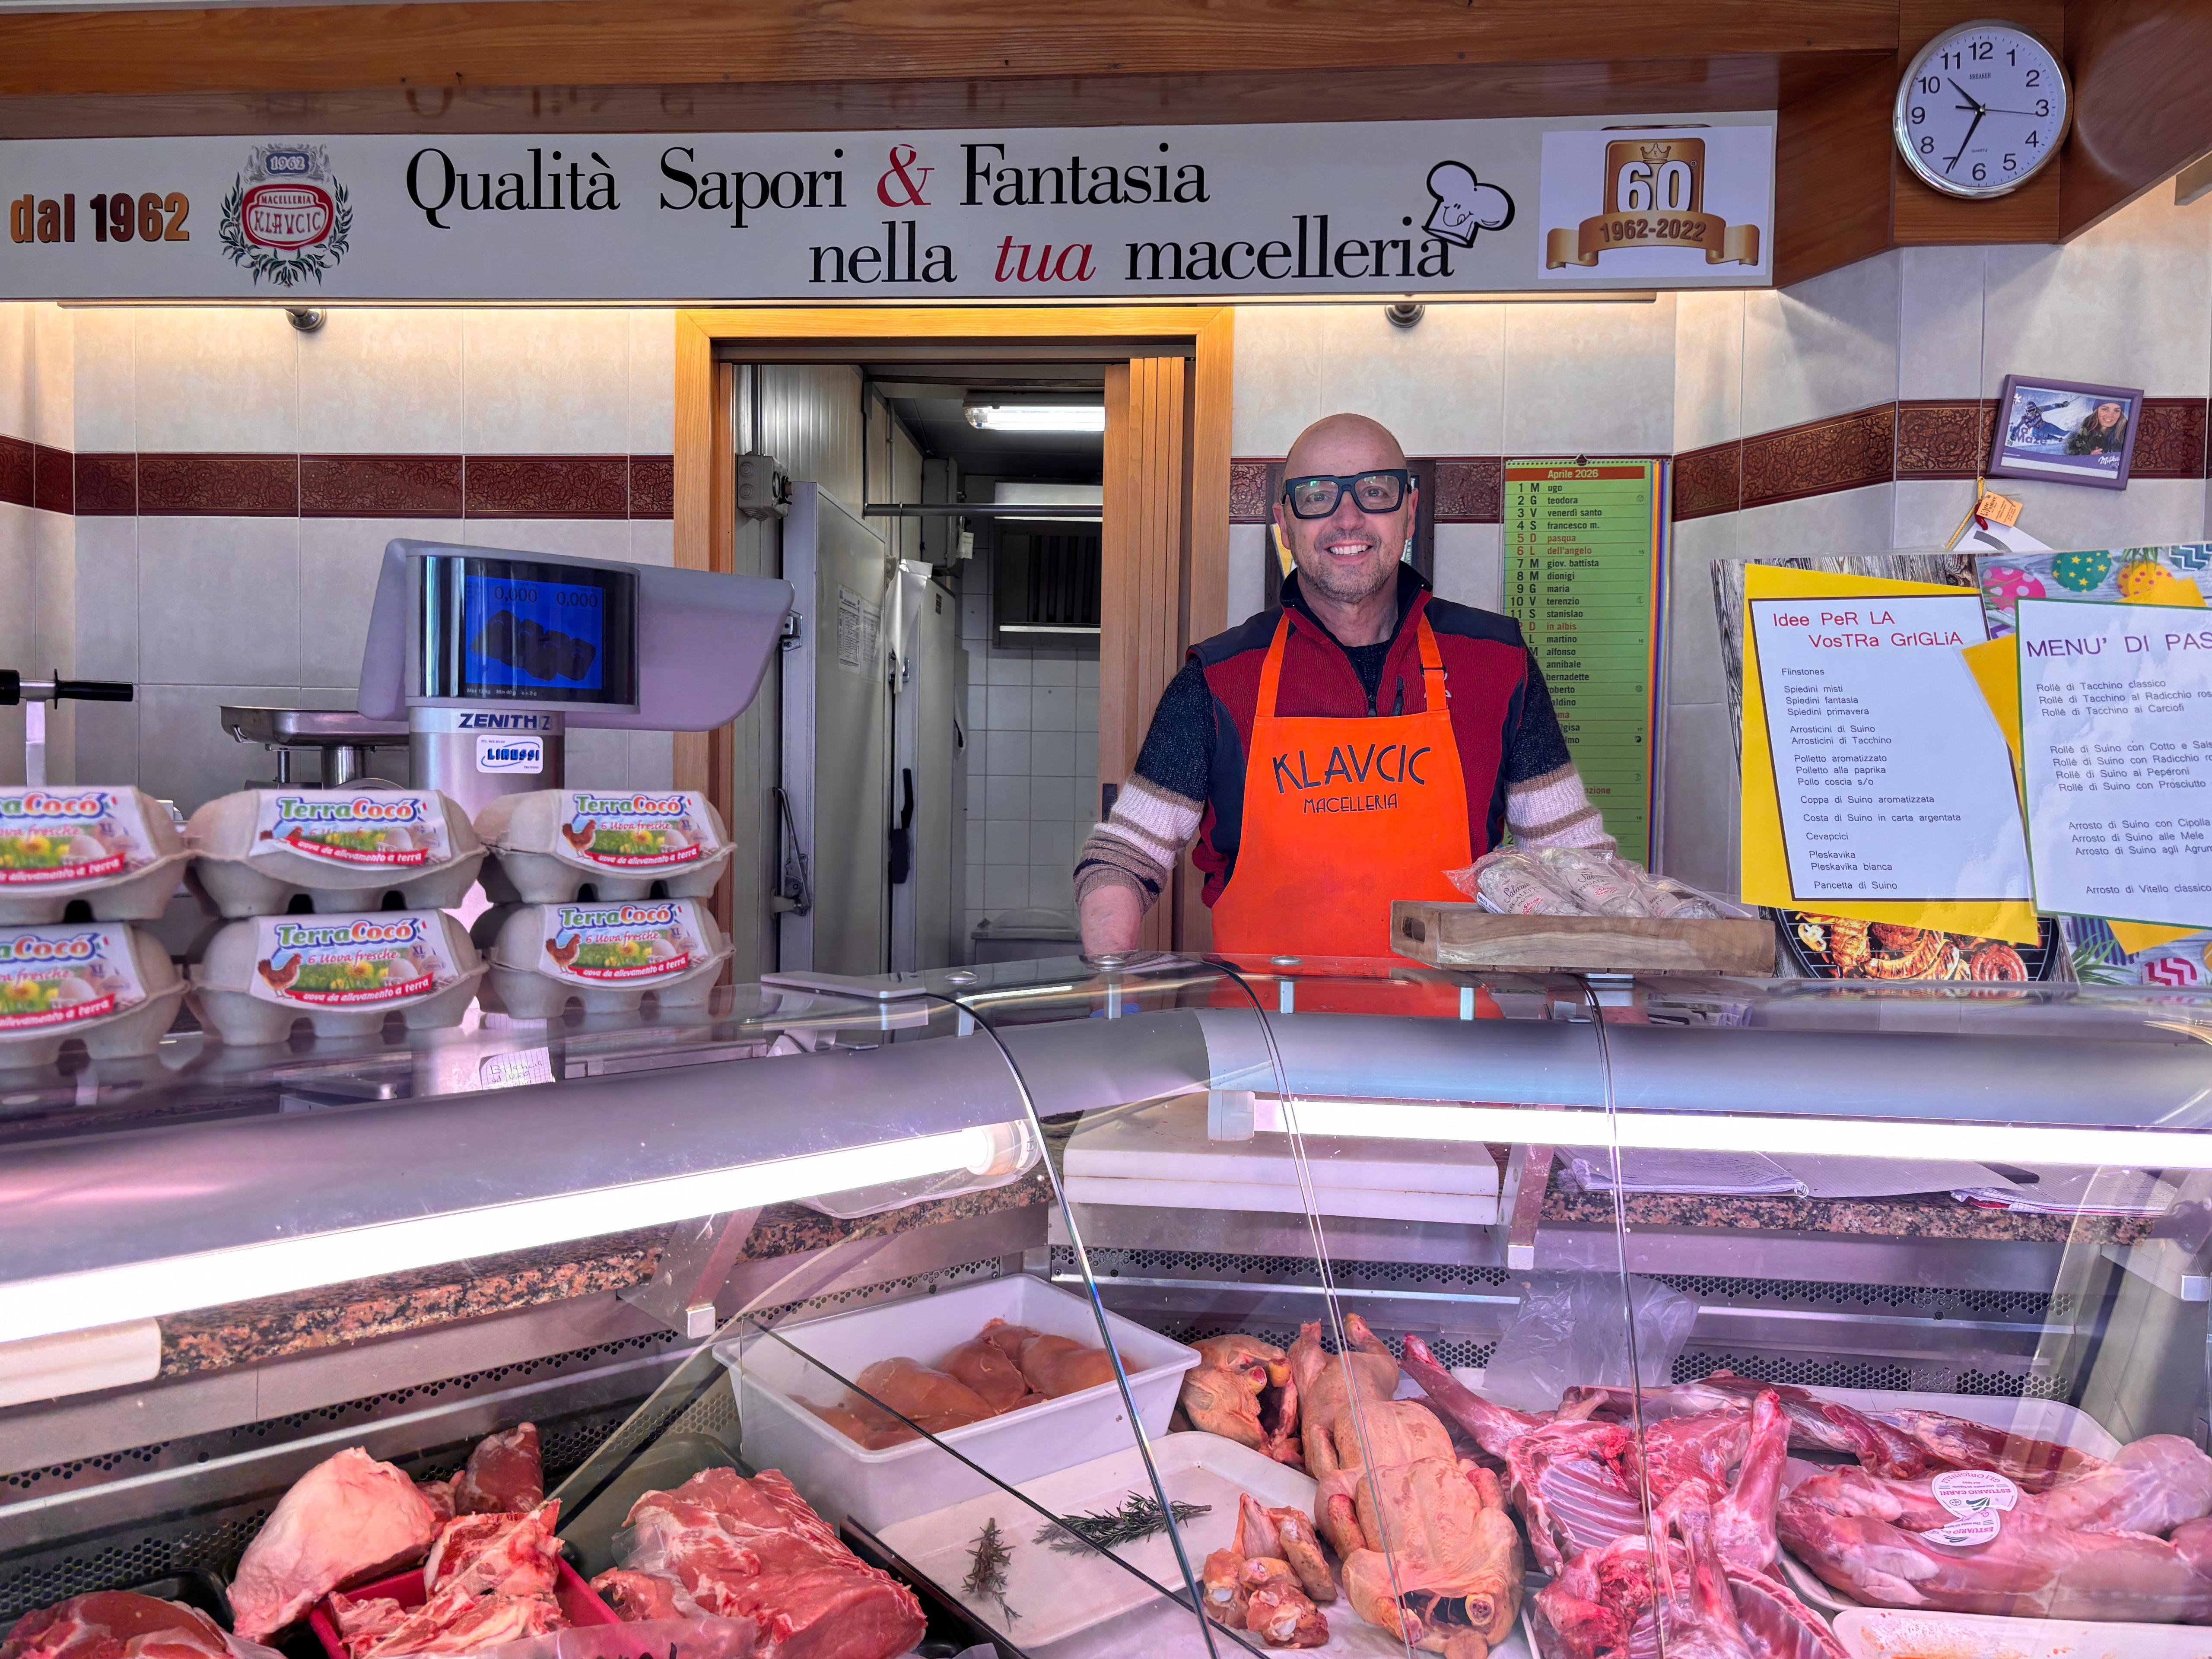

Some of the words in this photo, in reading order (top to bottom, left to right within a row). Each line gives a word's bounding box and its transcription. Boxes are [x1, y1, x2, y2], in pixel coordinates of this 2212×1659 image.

[1968, 42, 1993, 60] 12
[2007, 49, 2015, 67] 1
[1941, 52, 1961, 70] 11
[1919, 76, 1940, 94] 10
[2026, 70, 2039, 87] 2
[1912, 107, 1926, 124] 9
[2035, 99, 2049, 117] 3
[1921, 136, 1934, 153] 8
[2025, 130, 2039, 147] 4
[270, 156, 305, 171] 1962
[1943, 157, 1957, 174] 7
[2003, 153, 2016, 170] 5
[1972, 163, 1986, 181] 6
[406, 147, 621, 229] Qualità
[660, 147, 847, 228] Sapori
[877, 144, 934, 208] &
[960, 142, 1210, 205] Fantasia
[1617, 160, 1691, 212] 60
[261, 195, 312, 205] MACELLERIA
[10, 193, 75, 243] dal
[89, 192, 190, 242] 1962
[253, 210, 321, 234] KLAVCIC
[1600, 218, 1706, 242] 1962-2022
[808, 220, 957, 283] nella
[994, 235, 1096, 282] tua
[1124, 214, 1455, 280] macelleria
[1548, 470, 1573, 480] Aprile
[1575, 469, 1599, 478] 2026
[1519, 483, 1523, 492] 1
[1531, 483, 1539, 492] M
[1548, 485, 1562, 493] ugo
[1518, 496, 1524, 505] 2
[1530, 496, 1537, 505] G
[1518, 509, 1524, 518] 3
[1530, 508, 1537, 517] V
[1517, 521, 1524, 530] 4
[1530, 521, 1536, 530] S
[1517, 534, 1524, 543] 5
[1530, 534, 1536, 543] D
[1517, 546, 1524, 556] 6
[1530, 546, 1535, 555] L
[1548, 547, 1592, 556] dell'angelo
[1517, 559, 1524, 568] 7
[1530, 559, 1538, 568] M
[1547, 559, 1566, 569] giov.
[494, 586, 537, 602] 0,000
[1773, 613, 1809, 627] Idee
[1821, 612, 1857, 626] PeR
[1870, 611, 1895, 625] LA
[1808, 633, 1879, 648] VosTRa
[1891, 631, 1963, 646] GrIGLiA
[2124, 636, 2149, 653] DI
[1784, 686, 1818, 694] Spiedini
[2080, 681, 2123, 690] Tacchino
[2129, 680, 2166, 688] classico
[1786, 697, 1819, 705] Spiedini
[2085, 706, 2128, 715] Tacchino
[2148, 704, 2184, 713] Carciofi
[458, 714, 537, 728] ZENITH
[1272, 744, 1431, 794] KLAVCIC
[1855, 766, 1885, 775] paprika
[2148, 767, 2190, 777] Peperoni
[1303, 793, 1397, 814] MACELLERIA
[1801, 796, 1828, 805] Coppa
[2069, 822, 2102, 830] Arrosto
[2123, 820, 2149, 829] Suino
[2178, 819, 2210, 827] Cipolla
[1806, 833, 1848, 841] Cevapcici
[2086, 886, 2119, 894] Arrosto
[2174, 884, 2212, 892] classico
[308, 955, 316, 964] 6
[353, 949, 397, 968] fresche
[341, 989, 393, 1001] allevamento
[405, 979, 429, 992] terra
